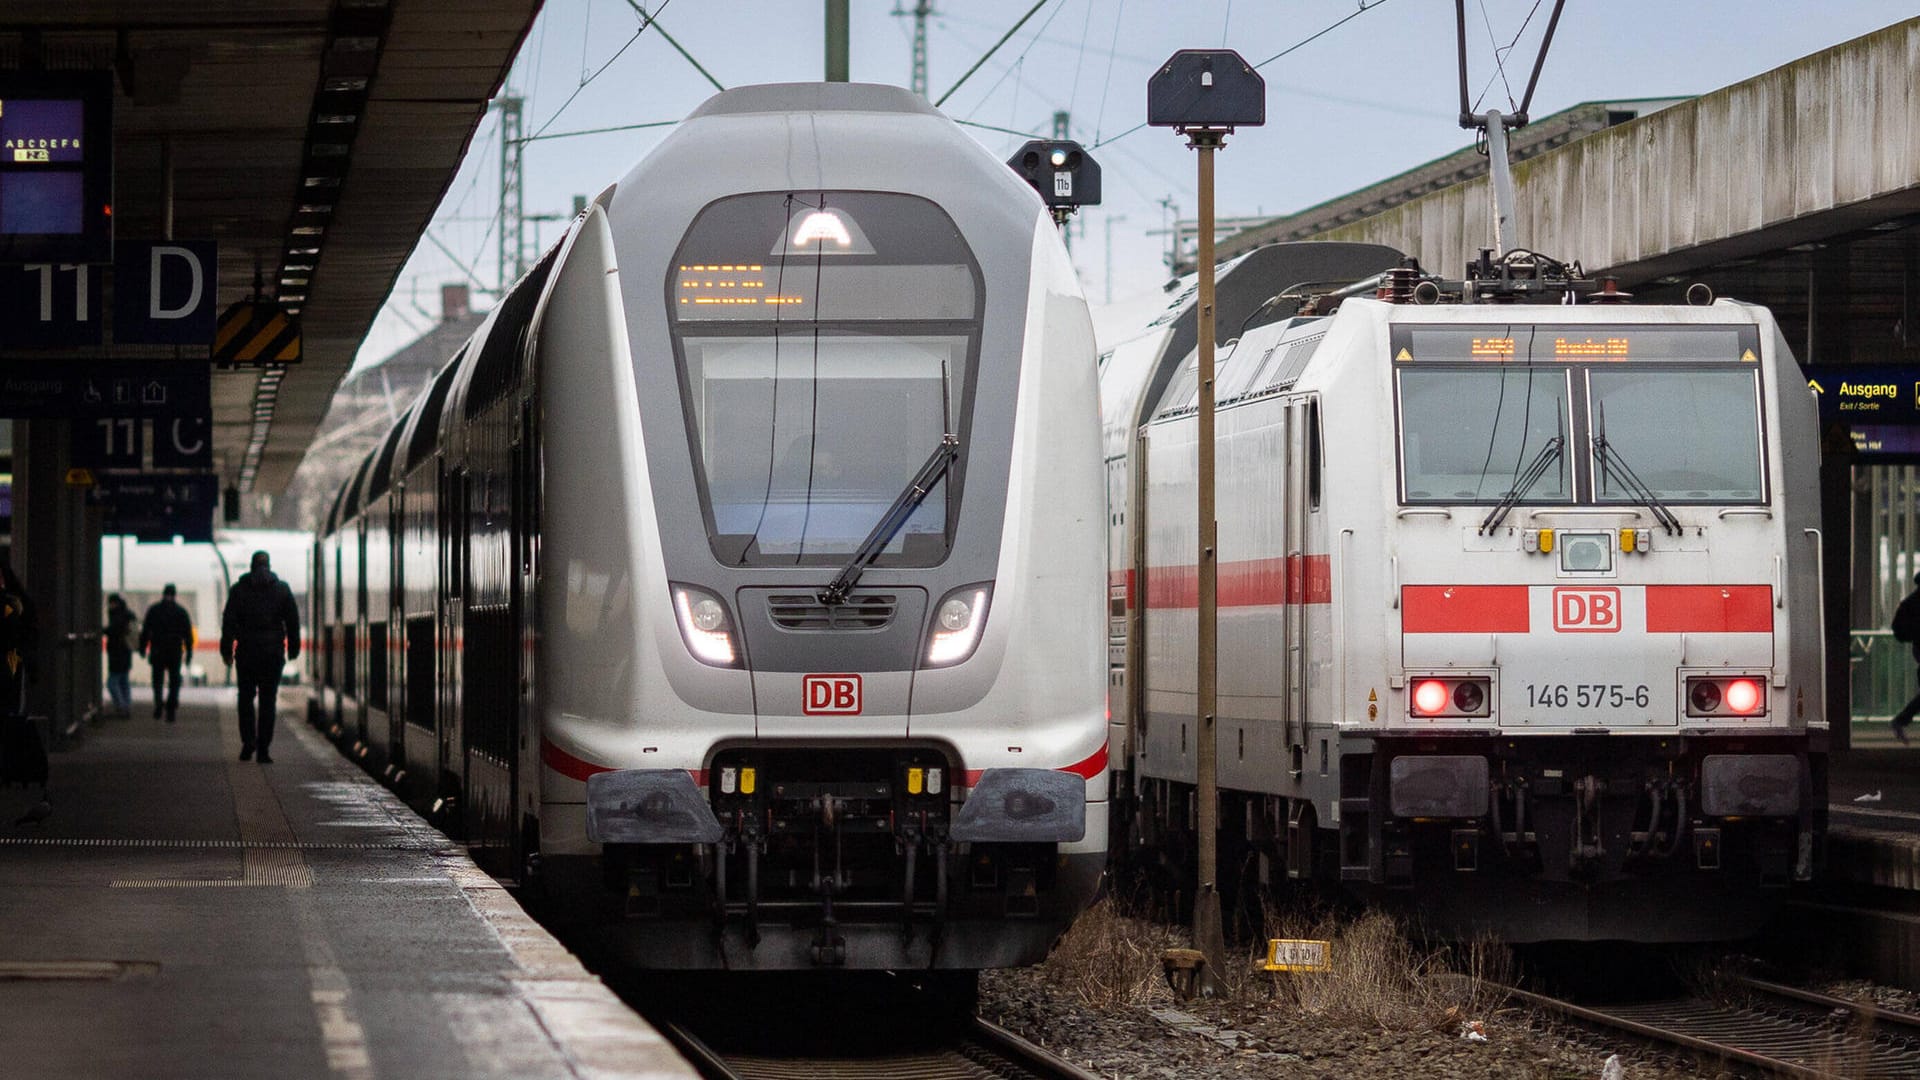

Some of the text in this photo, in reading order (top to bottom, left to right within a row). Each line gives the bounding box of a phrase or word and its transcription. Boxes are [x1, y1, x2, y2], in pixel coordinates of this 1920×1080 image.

[5, 139, 80, 148] A B C D E F G
[1056, 178, 1069, 191] 11b
[23, 246, 204, 321] 11 D
[1840, 382, 1897, 398] Ausgang
[96, 417, 206, 456] 11 C
[1561, 594, 1614, 626] DB
[810, 680, 856, 709] DB
[1526, 684, 1650, 708] 146 575-6
